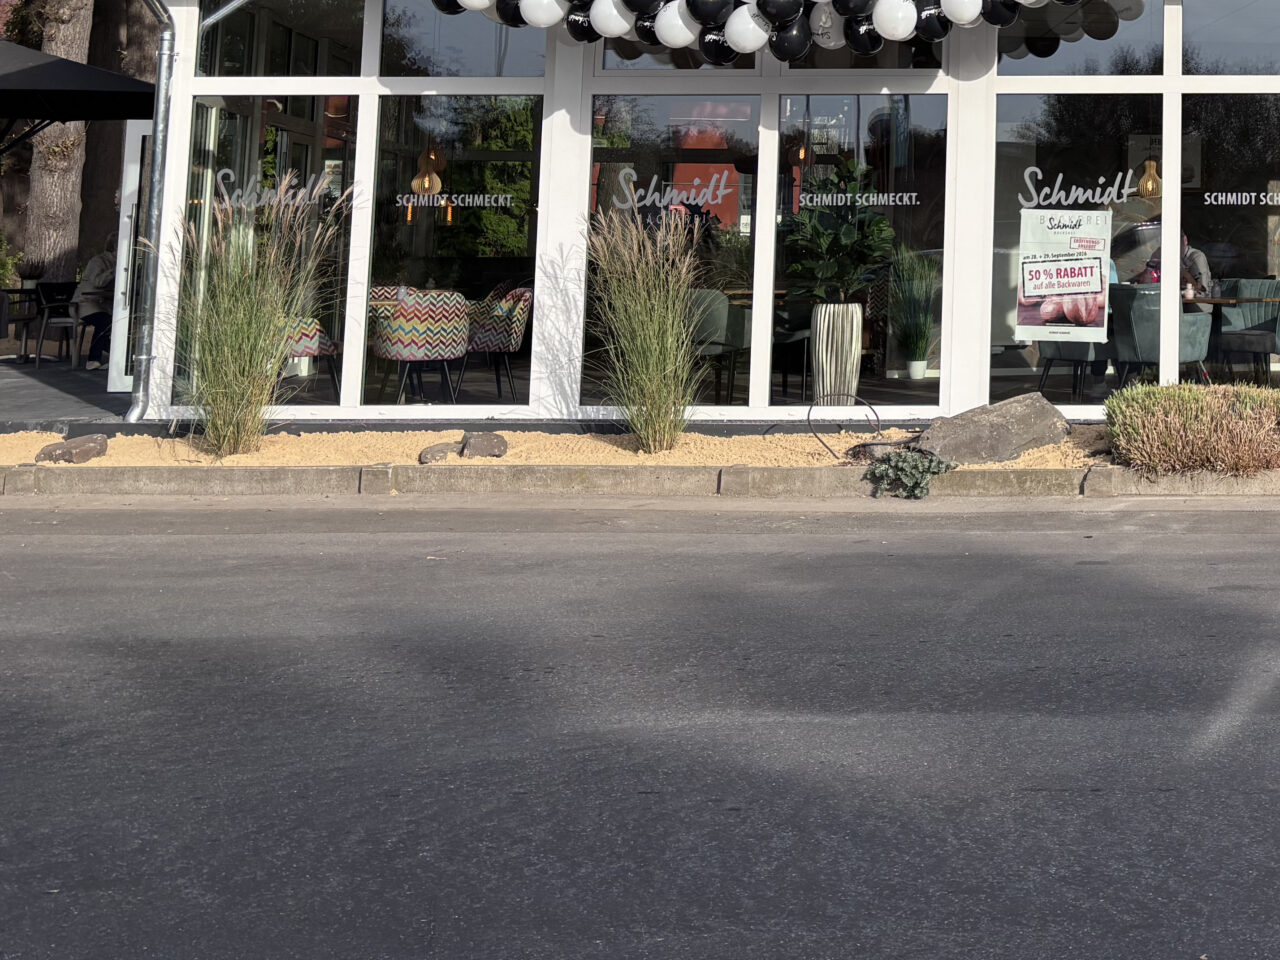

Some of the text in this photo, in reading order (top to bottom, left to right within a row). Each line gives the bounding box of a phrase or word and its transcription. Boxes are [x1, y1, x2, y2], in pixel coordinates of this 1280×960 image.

[613, 168, 733, 209] Schmidt
[1018, 166, 1138, 208] Schmidt
[395, 193, 514, 207] SCHMIDT SCHMECKT.
[799, 192, 921, 206] SCHMIDT SCHMECKT.
[1204, 192, 1257, 205] SCHMIDT
[1046, 217, 1084, 230] Schmidt
[1051, 251, 1076, 259] September
[1028, 269, 1041, 281] 50
[1043, 268, 1053, 280] %
[1044, 281, 1056, 289] alle
[1057, 280, 1091, 289] Backwaren
